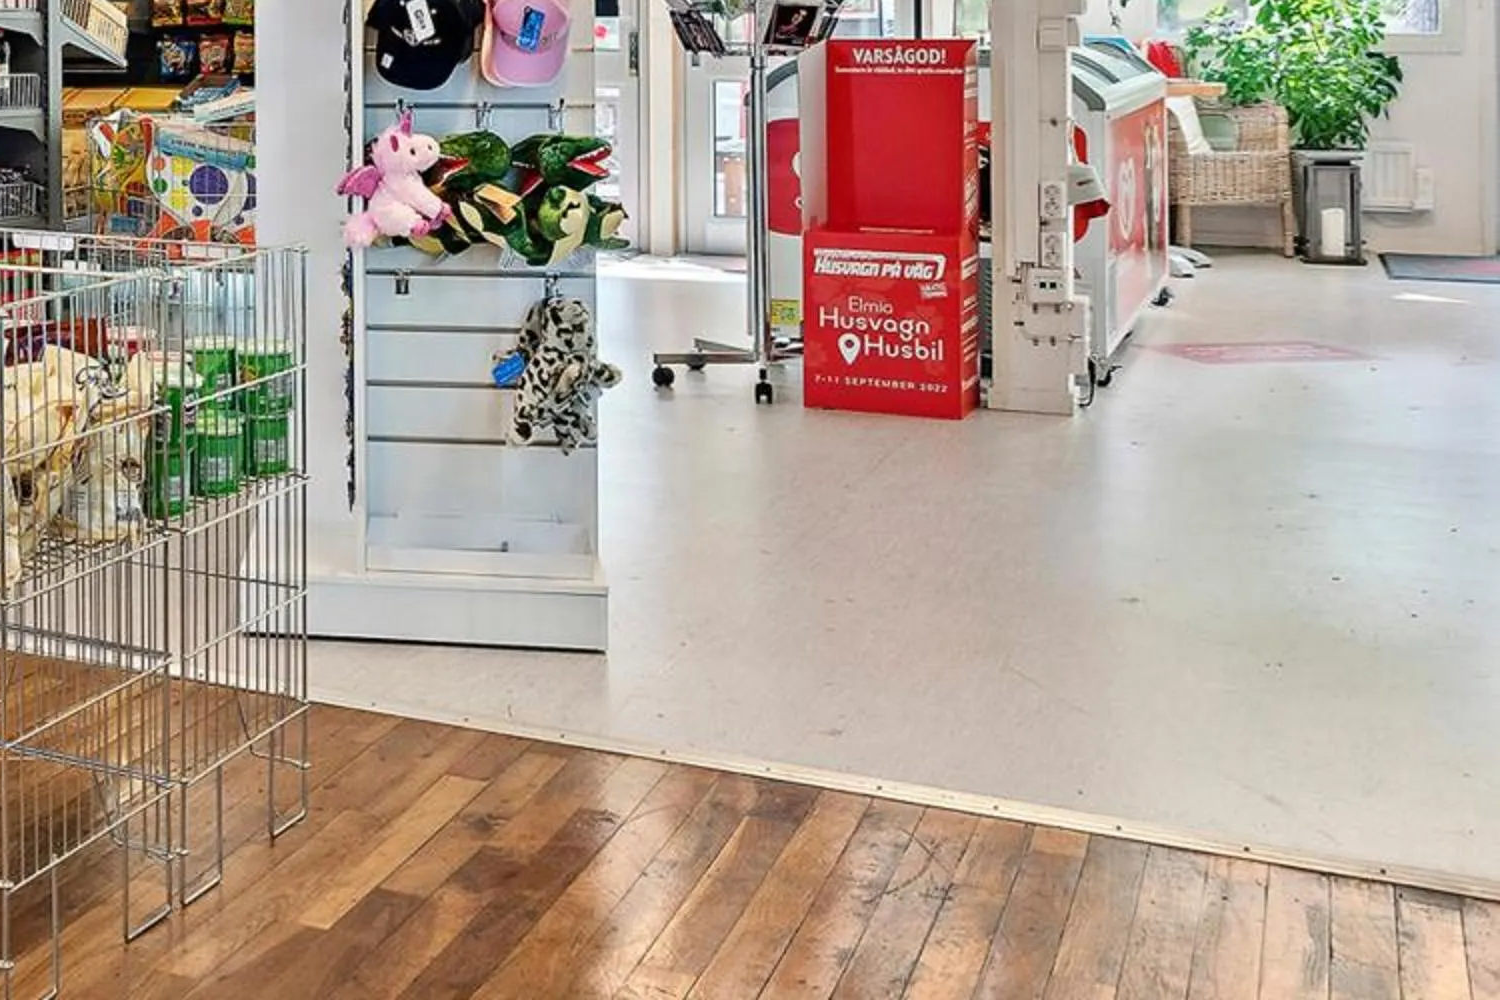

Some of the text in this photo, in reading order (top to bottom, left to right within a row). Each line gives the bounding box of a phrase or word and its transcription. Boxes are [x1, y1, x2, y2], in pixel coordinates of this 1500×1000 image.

[852, 45, 947, 65] VARSÅGOD!
[848, 295, 894, 314] Elmia
[819, 306, 930, 342] Husvagn
[864, 334, 944, 361] Husbil
[845, 377, 915, 390] SEPTEMBER
[919, 383, 948, 393] 2022
